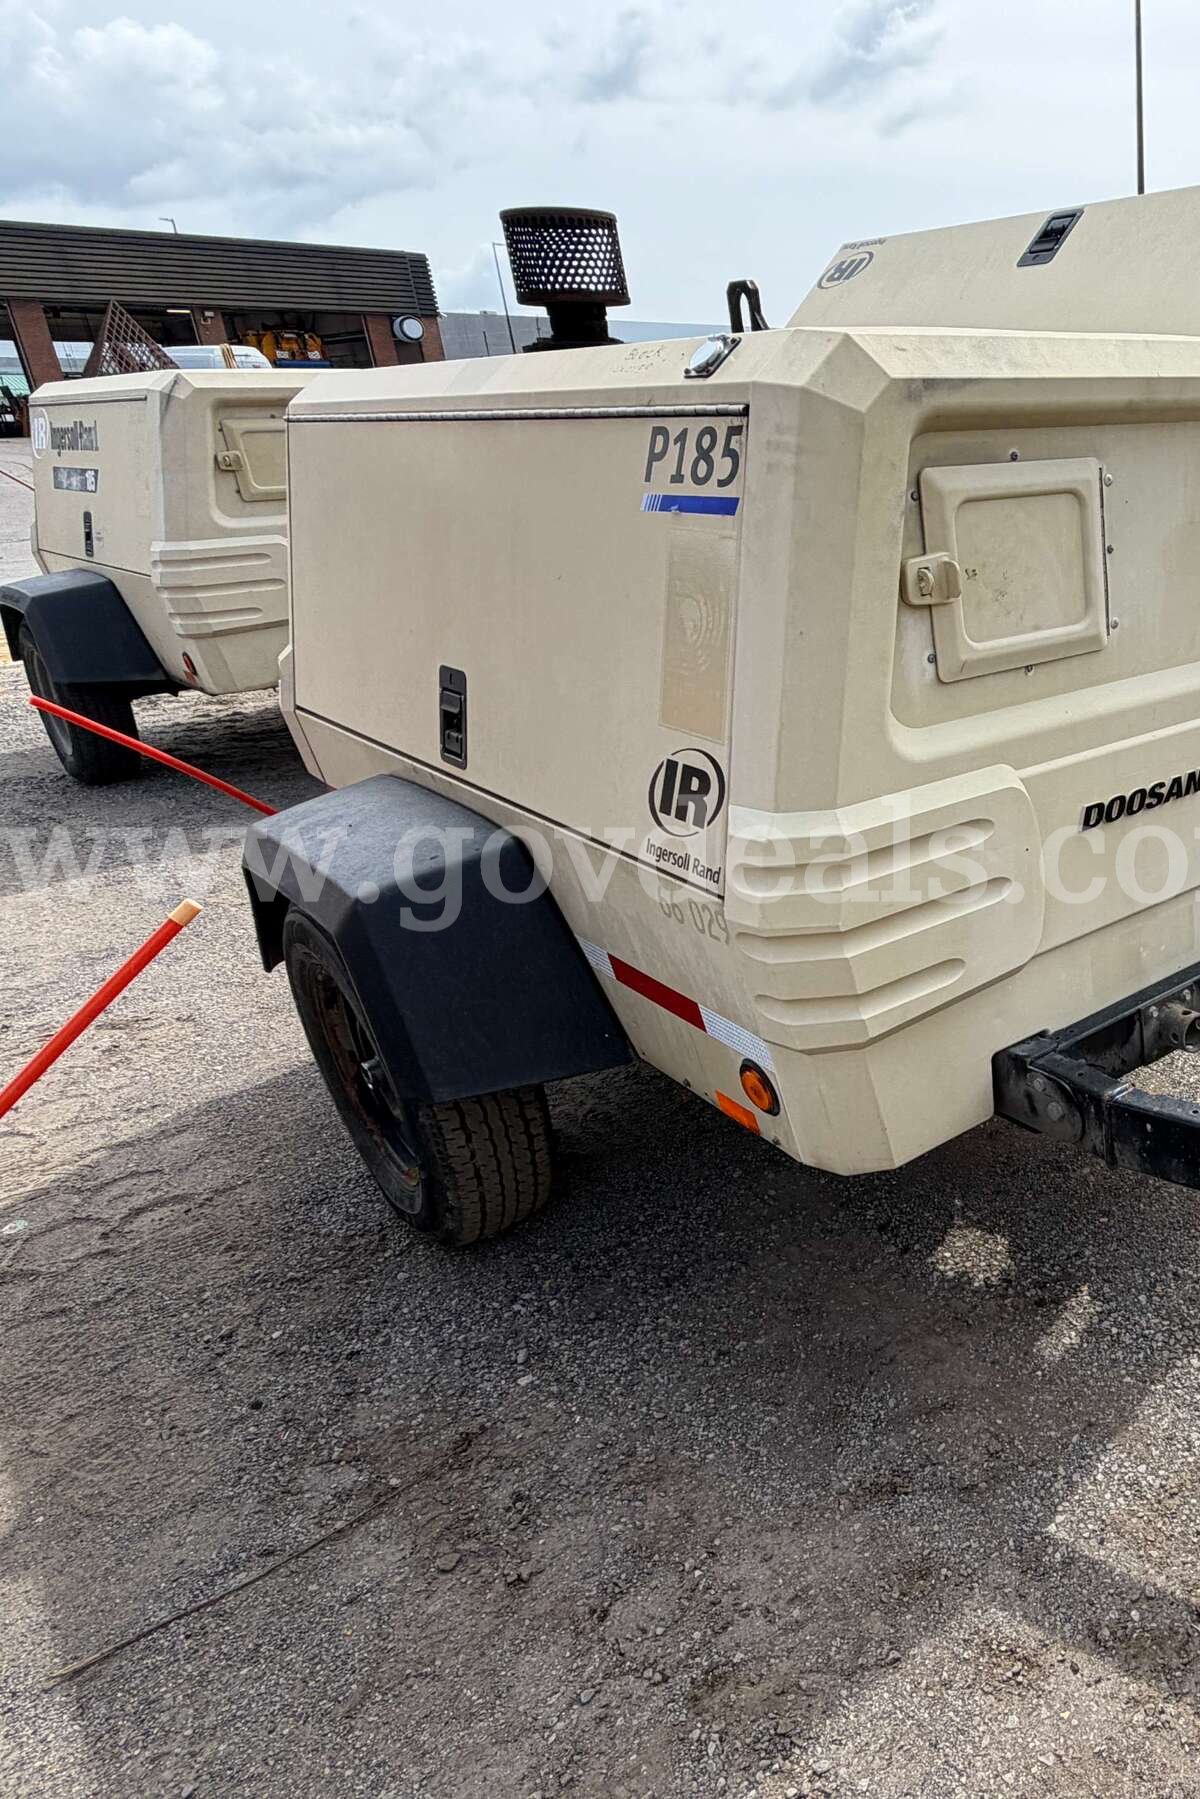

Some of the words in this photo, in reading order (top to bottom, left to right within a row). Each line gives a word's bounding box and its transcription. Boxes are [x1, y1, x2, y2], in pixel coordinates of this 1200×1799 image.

[644, 425, 744, 488] P185
[659, 758, 711, 829] IR
[646, 838, 690, 872] Ingersoll
[692, 858, 721, 885] Rand
